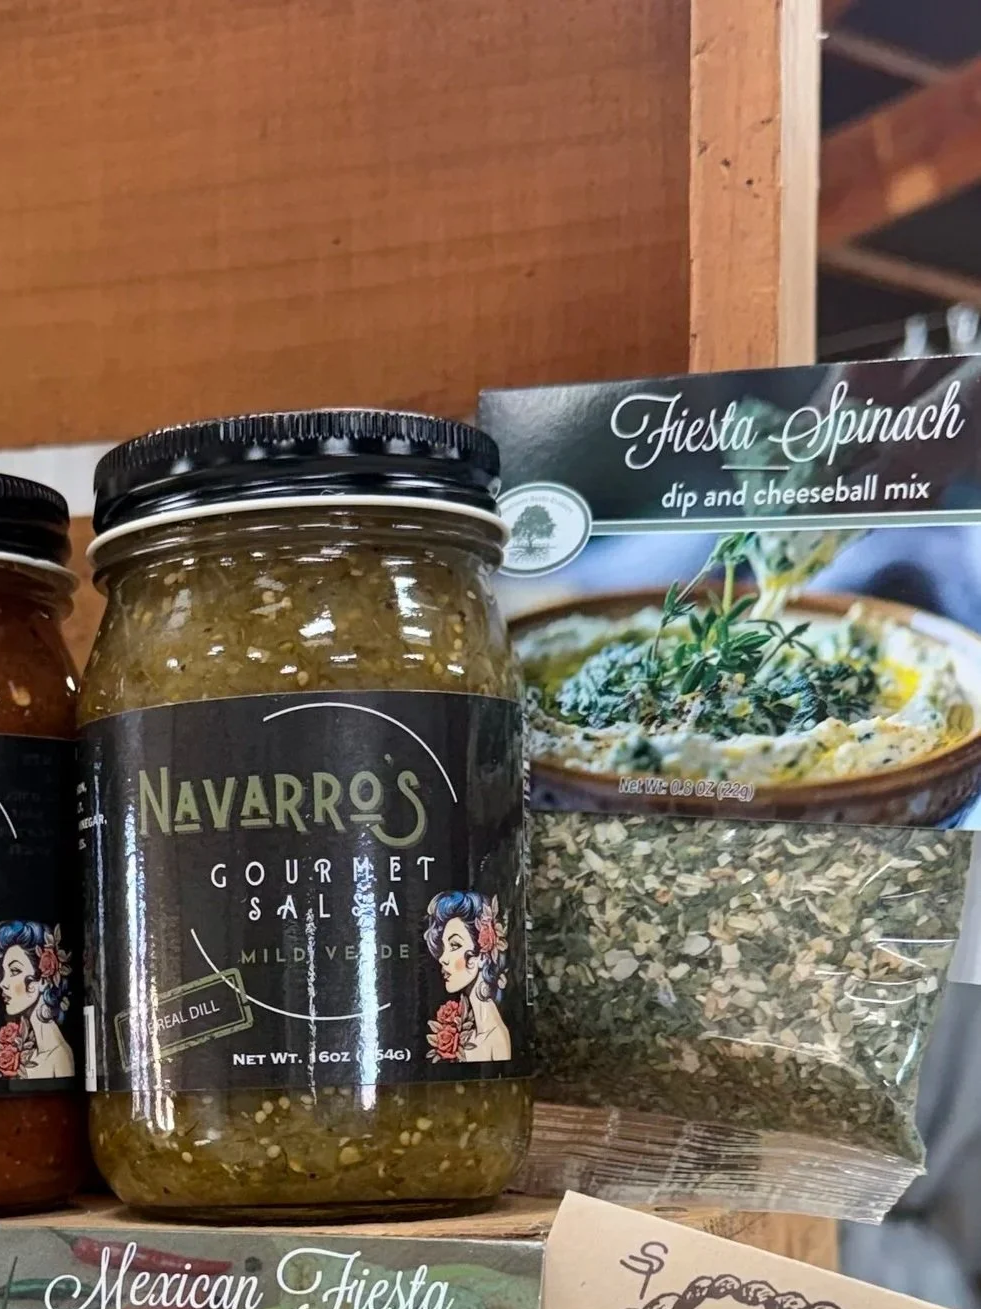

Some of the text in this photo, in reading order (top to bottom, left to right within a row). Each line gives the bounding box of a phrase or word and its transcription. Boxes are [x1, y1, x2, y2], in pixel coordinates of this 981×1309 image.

[610, 380, 966, 470] Fiesta Spinach
[661, 472, 930, 517] dip and cheeseball mix
[138, 754, 427, 849] NAVARRO'S
[670, 778, 695, 797] 0.8
[211, 856, 435, 888] GOURMET
[248, 890, 400, 922] SALSA
[241, 943, 410, 965] MILD VEDE
[187, 1000, 221, 1021] DILL
[233, 1053, 267, 1067] NET
[271, 1051, 304, 1066] WT.
[355, 1048, 412, 1065] (54G)
